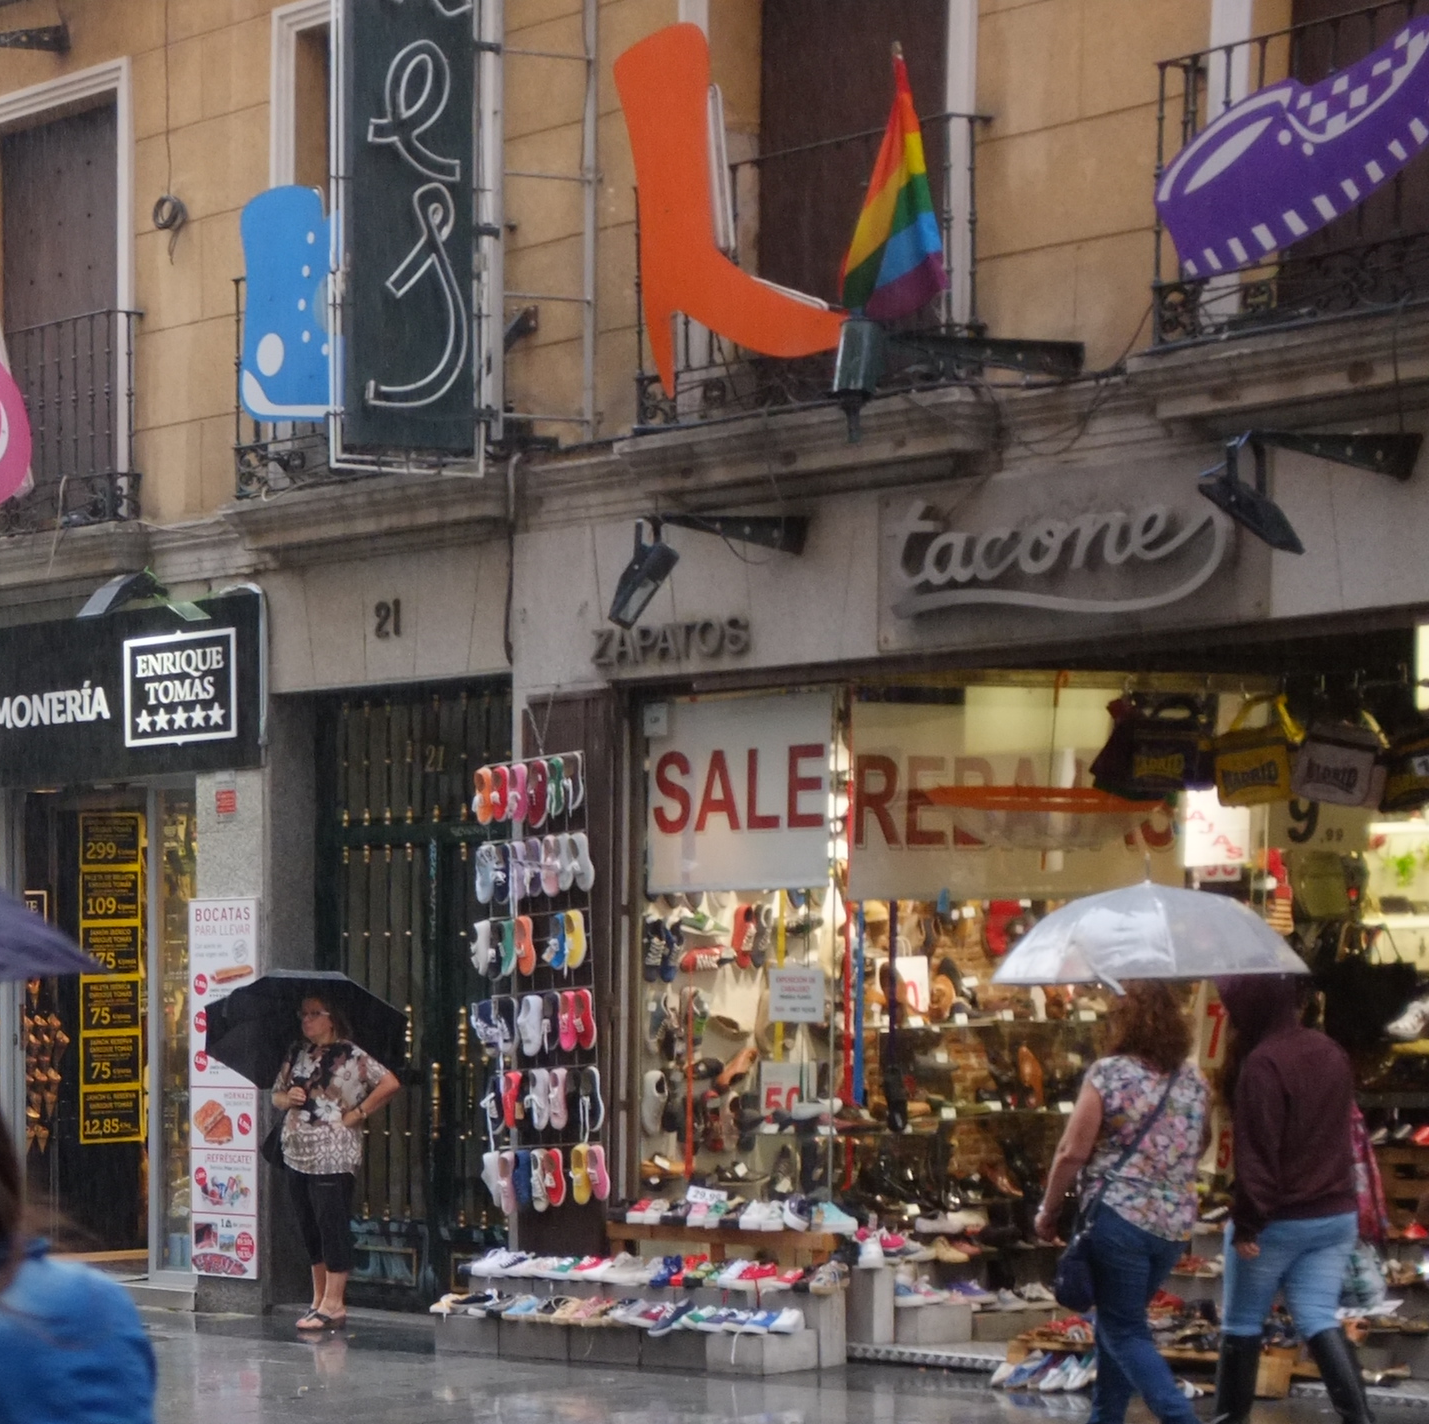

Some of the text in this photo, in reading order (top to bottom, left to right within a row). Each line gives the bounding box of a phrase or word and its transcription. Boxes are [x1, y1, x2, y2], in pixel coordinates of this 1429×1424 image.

[893, 500, 1235, 612] tacone
[375, 598, 402, 638] 21
[592, 617, 751, 667] ZAPATOS
[136, 646, 225, 680] ENRIQUE
[652, 743, 825, 834] SALE
[86, 841, 117, 860] 299
[86, 896, 117, 915] 109
[194, 907, 251, 922] BOCATAS
[194, 924, 251, 936] PARA LLEVAR
[91, 1006, 111, 1025] 75
[91, 1061, 112, 1080] 75
[84, 1117, 120, 1137] 12,85
